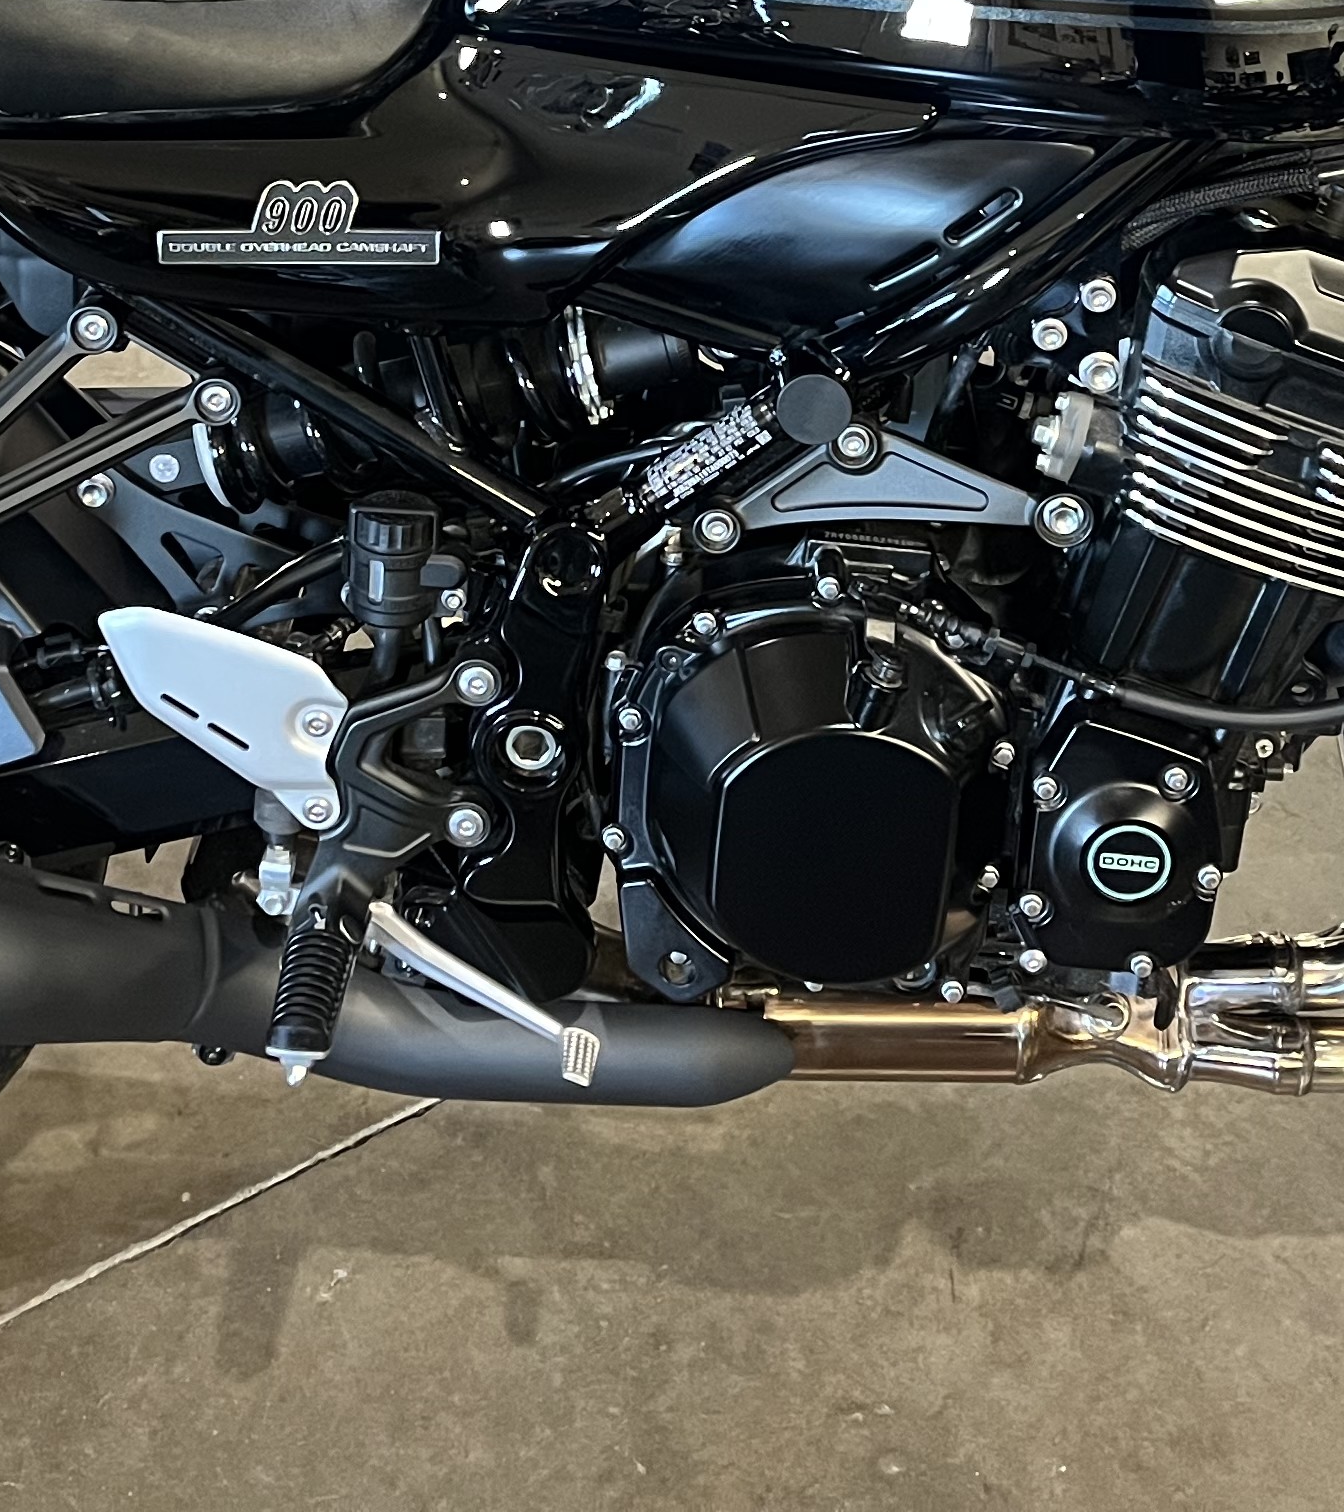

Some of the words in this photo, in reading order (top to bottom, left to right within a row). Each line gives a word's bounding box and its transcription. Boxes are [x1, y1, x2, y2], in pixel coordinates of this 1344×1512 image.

[261, 196, 347, 236] 900
[169, 242, 237, 253] DOUBLE
[240, 242, 332, 253] OVERHEAD
[336, 242, 429, 253] CAMSHAFT
[1102, 855, 1157, 870] DOHC
